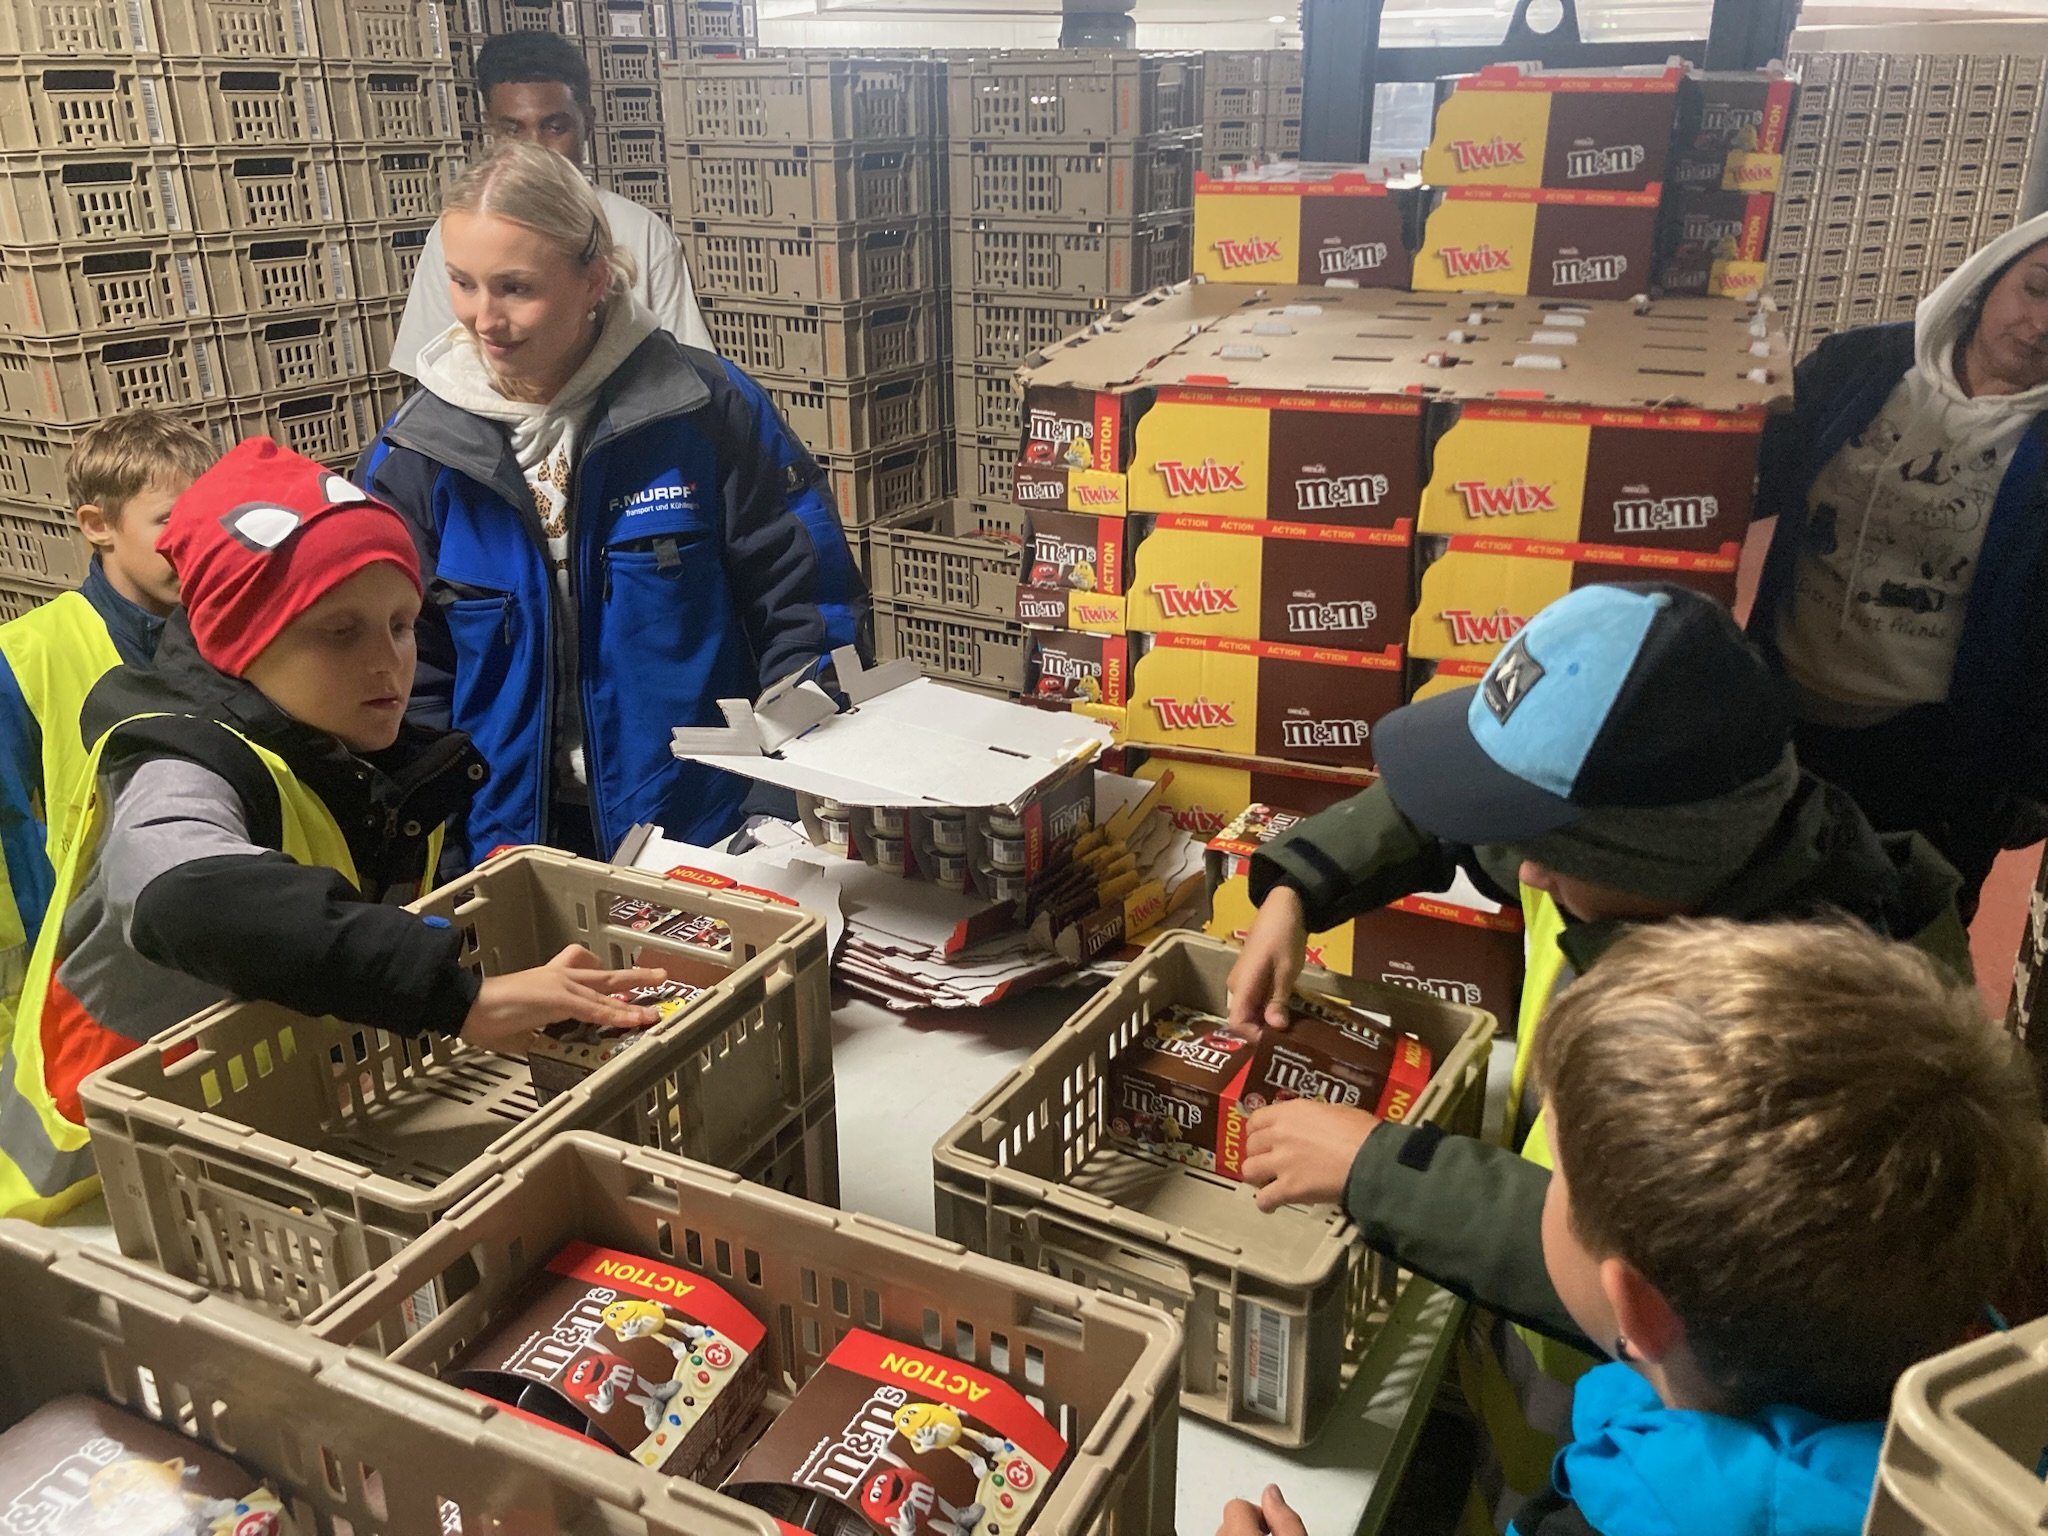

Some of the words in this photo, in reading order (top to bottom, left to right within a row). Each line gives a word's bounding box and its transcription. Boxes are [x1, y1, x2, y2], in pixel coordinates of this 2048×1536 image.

[1452, 136, 1525, 170] Twix
[1215, 236, 1282, 269] Twix
[1440, 244, 1512, 277] Twix
[1100, 416, 1112, 472] ACTION
[1076, 485, 1121, 505] Twix
[1155, 458, 1246, 497] Twix
[626, 505, 654, 517] Transport
[656, 503, 669, 512] und
[1456, 478, 1557, 518] Twix
[1175, 518, 1208, 528] ACTION
[1220, 521, 1254, 531] ACTION
[1272, 526, 1306, 536] ACTION
[1319, 529, 1355, 540] ACTION
[1368, 532, 1406, 543] ACTION
[1104, 542, 1115, 594] ACTION
[1473, 539, 1512, 550] ACTION
[1526, 543, 1565, 556] ACTION
[1584, 548, 1624, 560] ACTION
[1638, 552, 1678, 565] ACTION
[1694, 557, 1735, 570] ACTION
[1077, 605, 1119, 624] Twix
[1151, 580, 1240, 616] Twix
[1173, 636, 1206, 646] ACTION
[1218, 640, 1250, 651] ACTION
[1267, 646, 1301, 657] ACTION
[1313, 652, 1348, 662] ACTION
[1361, 656, 1396, 668] ACTION
[1108, 658, 1120, 706] ACTION
[1151, 696, 1236, 730] Twix
[1282, 720, 1368, 747] m&m's
[1030, 827, 1039, 871] CTION
[672, 868, 726, 886] ACTION
[1418, 902, 1460, 918] ACTION
[1224, 1106, 1242, 1173] ACTION
[594, 1258, 697, 1298] ACTION
[500, 1330, 540, 1370] chocolate
[512, 1287, 618, 1382] m&m's
[880, 1352, 992, 1402] ACTION
[792, 1436, 830, 1483] chocolate
[804, 1385, 907, 1500] m&m's
